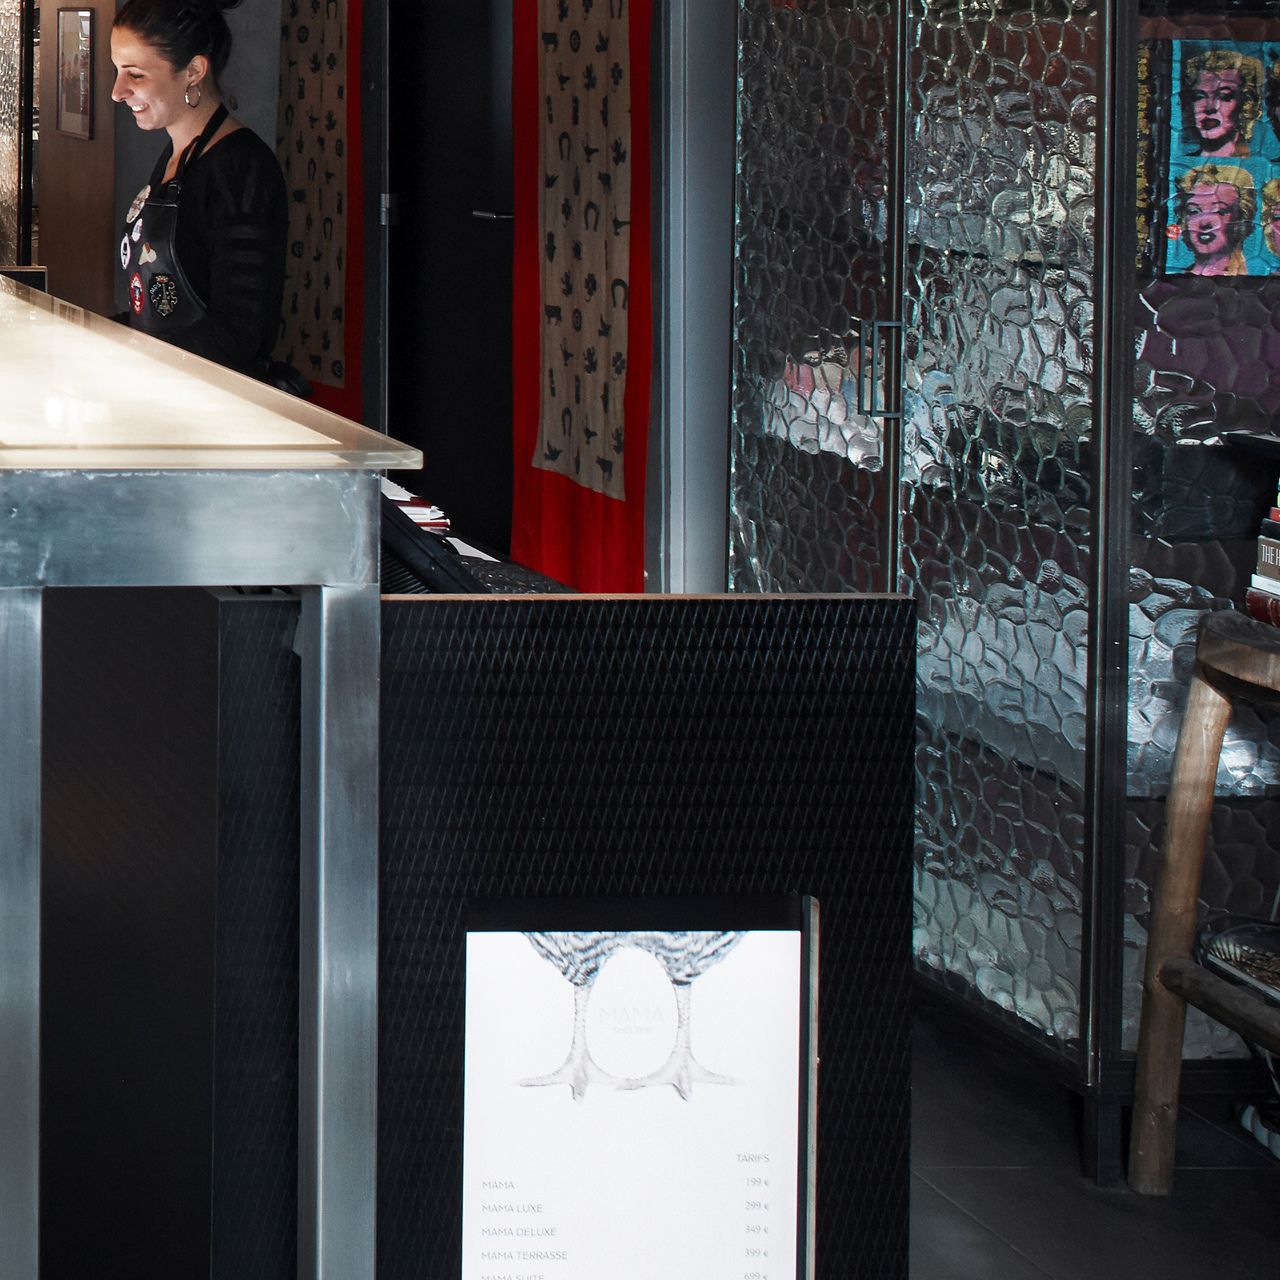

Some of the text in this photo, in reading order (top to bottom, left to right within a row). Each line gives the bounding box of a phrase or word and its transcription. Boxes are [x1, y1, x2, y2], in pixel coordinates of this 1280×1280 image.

[1260, 543, 1274, 567] THE
[736, 1153, 771, 1164] TARIFS
[481, 1180, 515, 1191] MAMA
[481, 1203, 543, 1214] MAMA LUXE
[481, 1226, 558, 1237] MAMA DELUXE
[481, 1250, 568, 1261] MAMA TERRASSE
